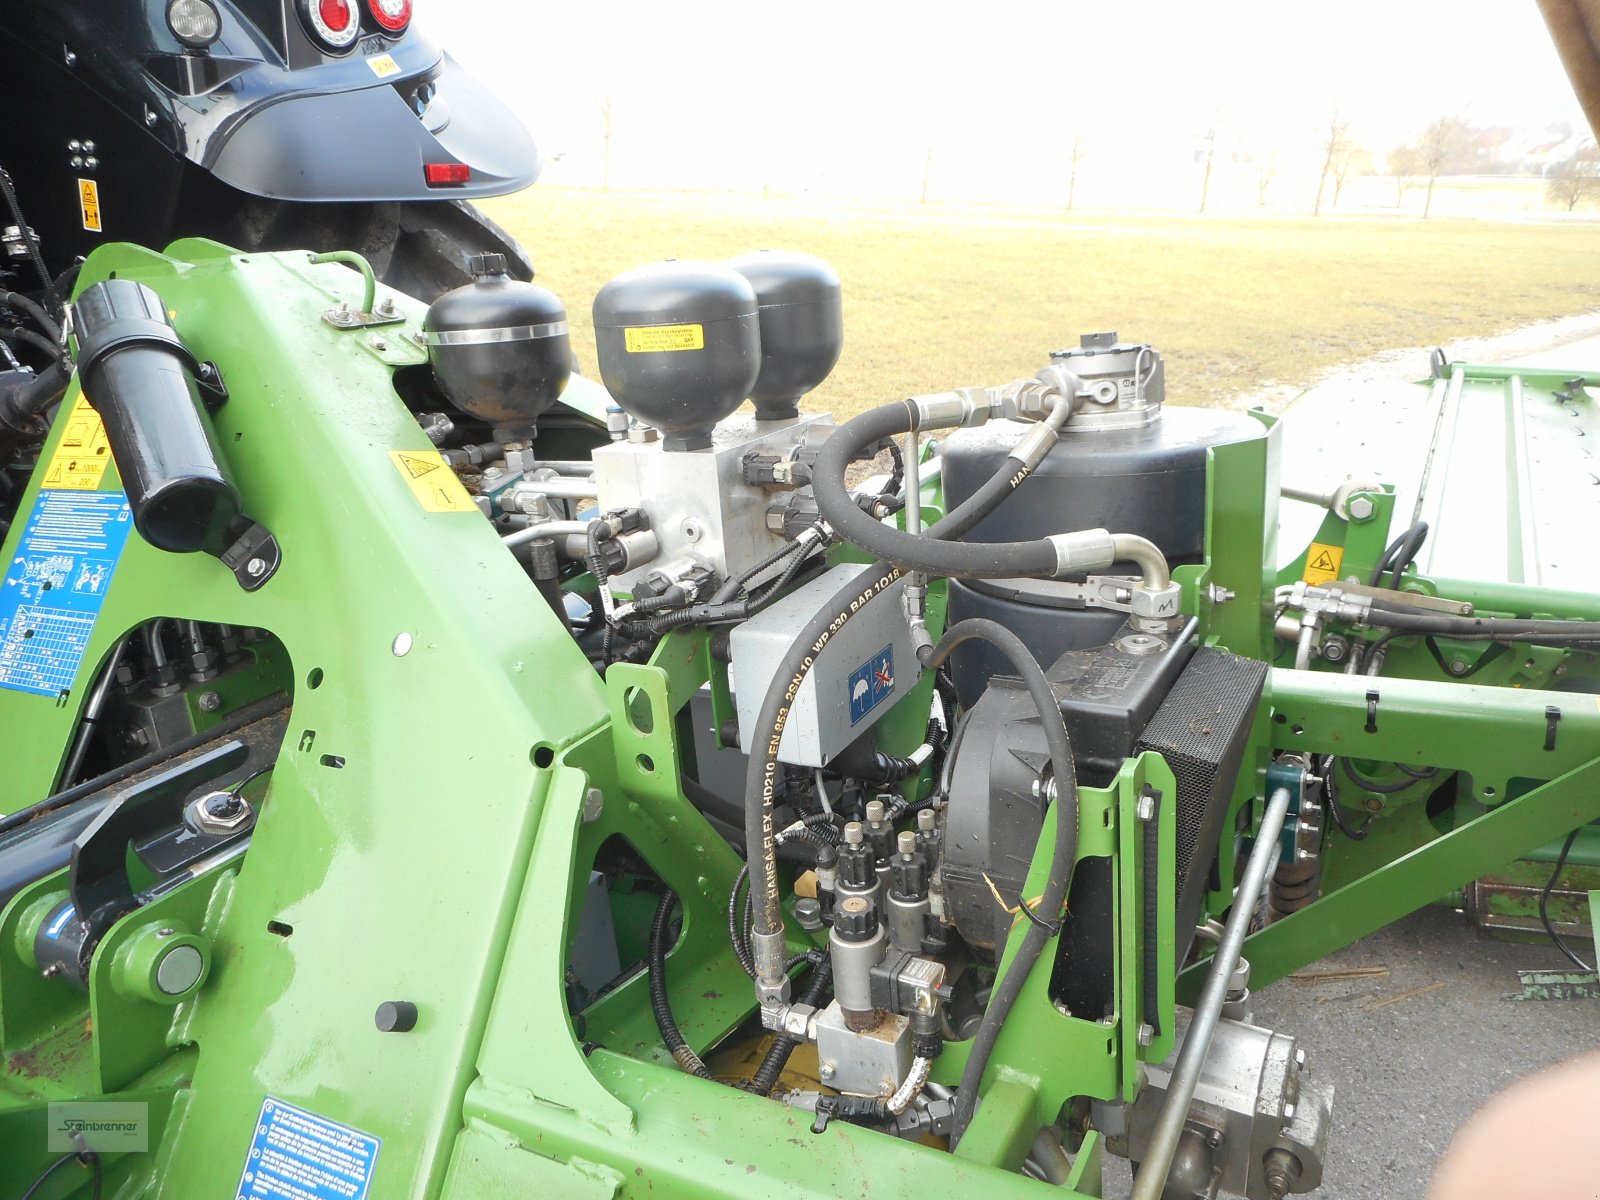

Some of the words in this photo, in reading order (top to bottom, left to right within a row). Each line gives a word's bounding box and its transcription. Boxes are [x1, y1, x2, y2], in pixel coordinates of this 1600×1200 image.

[850, 589, 873, 613] BAR
[829, 612, 848, 634] 330
[812, 632, 829, 653] WP
[800, 656, 813, 672] 10
[785, 673, 803, 701] 2SN
[774, 707, 789, 730] 853
[769, 733, 780, 754] EN
[763, 762, 776, 806] HD210
[762, 812, 779, 899] HANSA-FLEX
